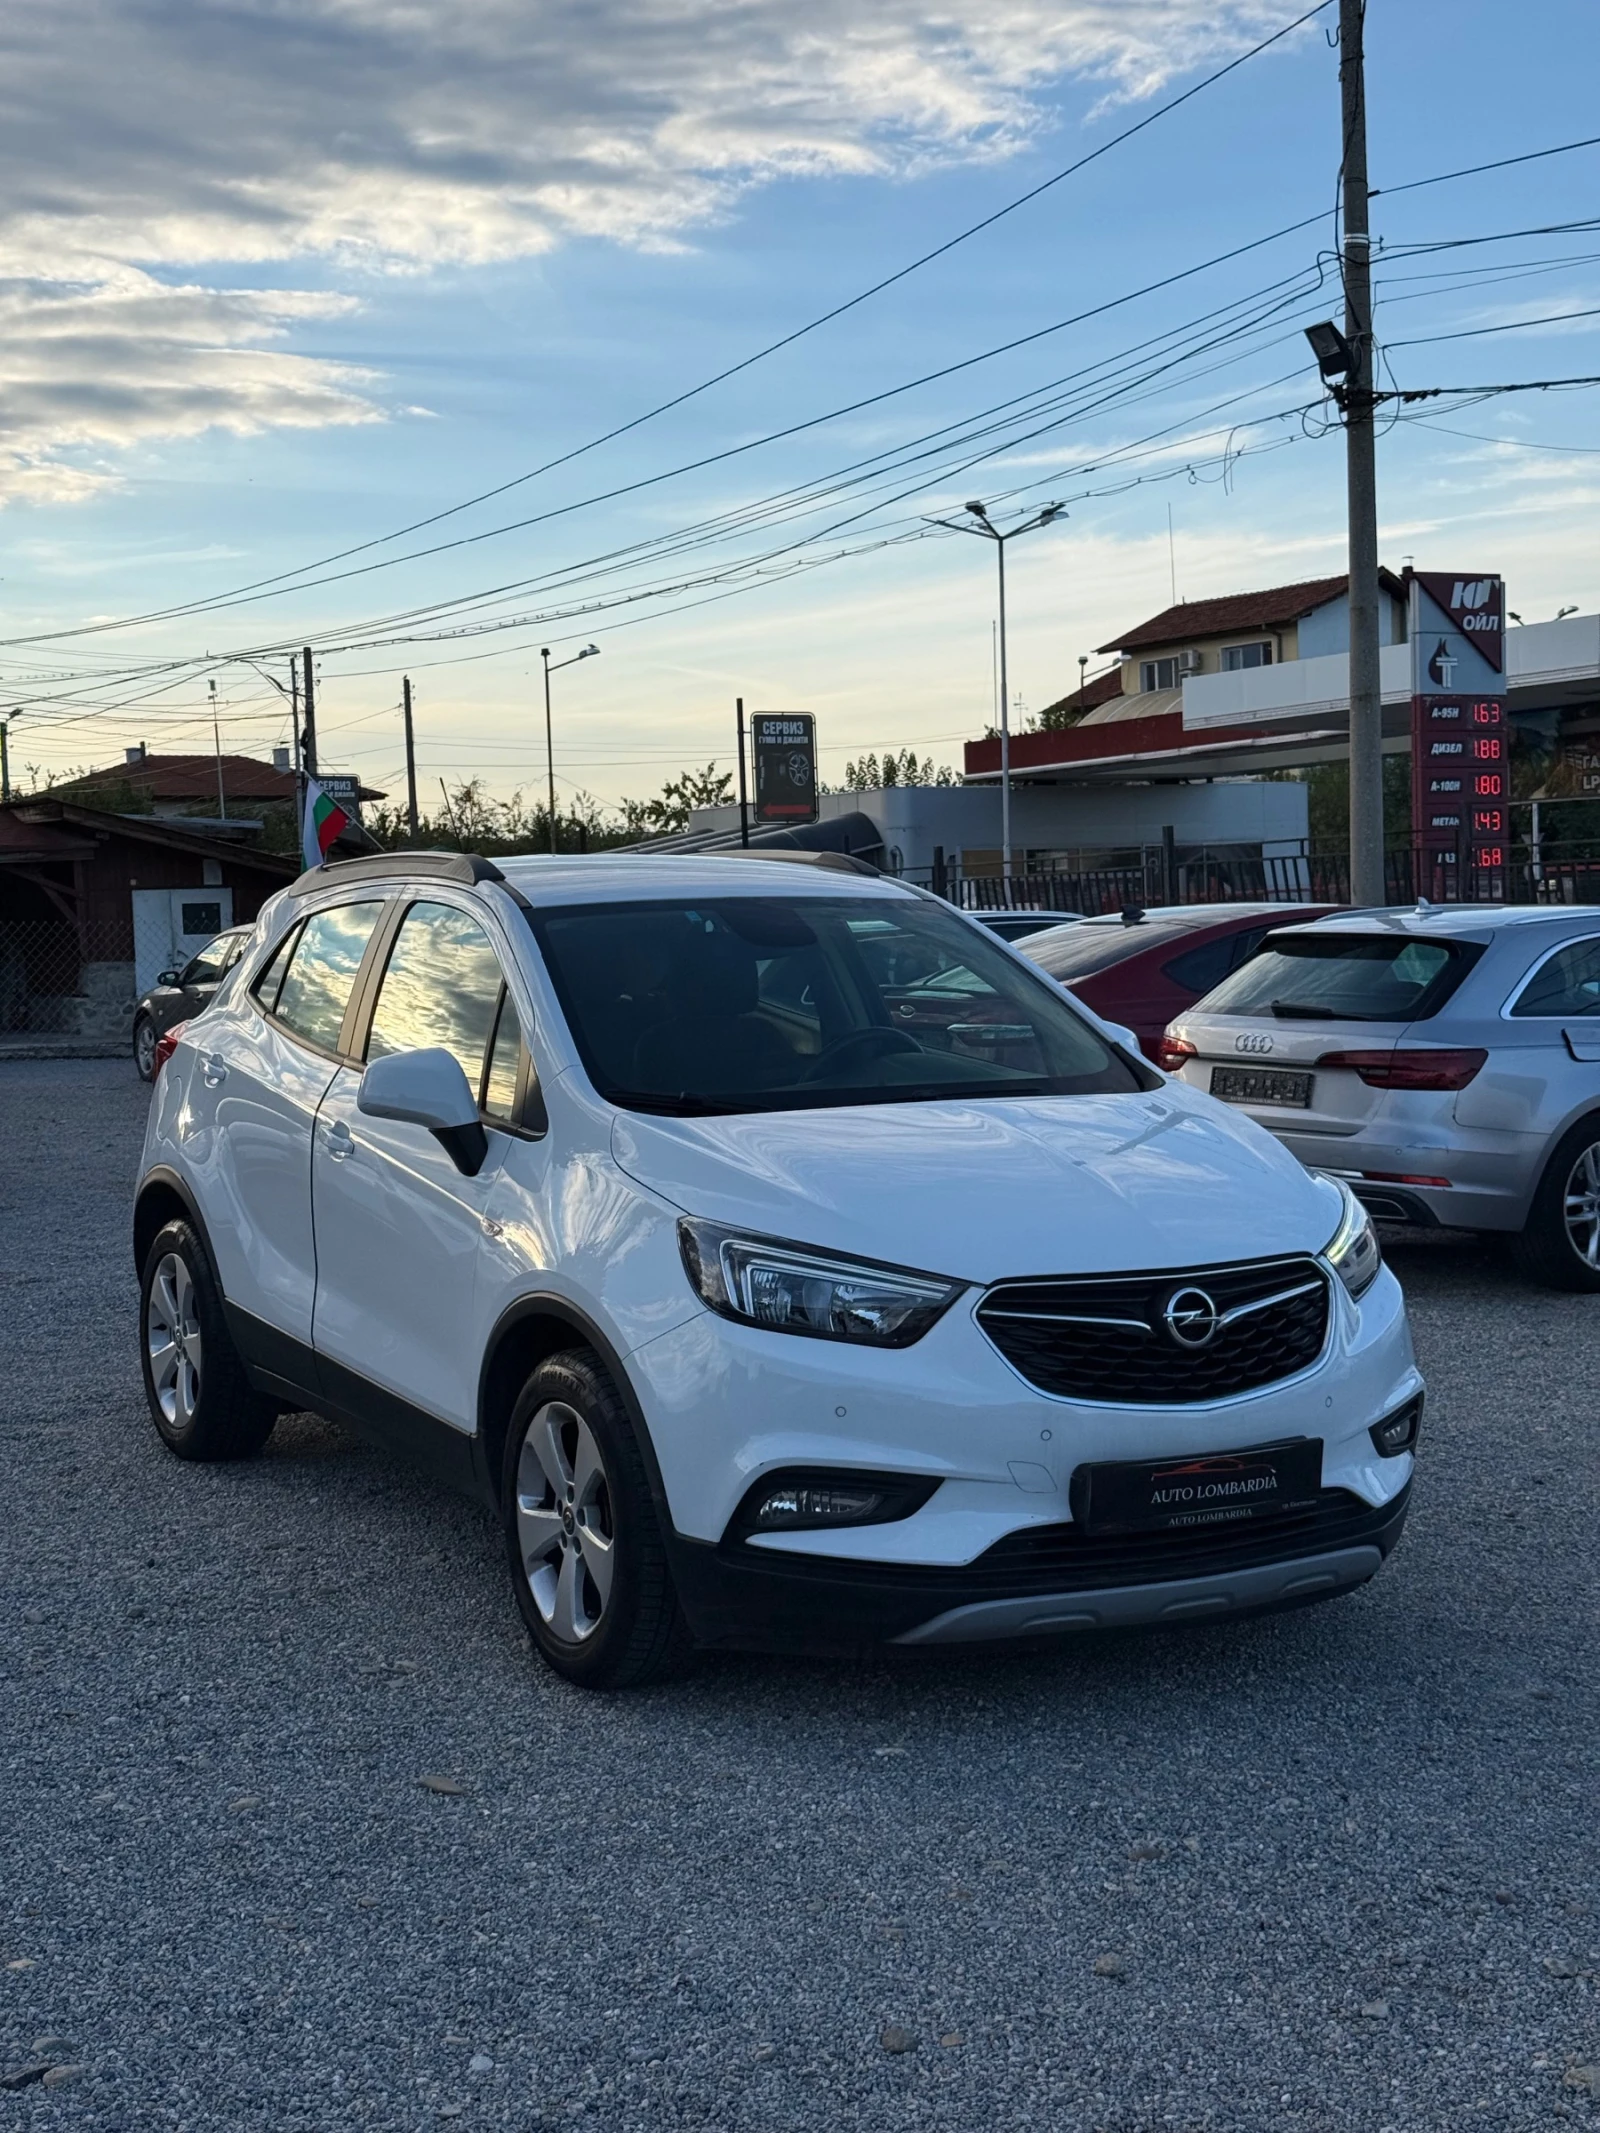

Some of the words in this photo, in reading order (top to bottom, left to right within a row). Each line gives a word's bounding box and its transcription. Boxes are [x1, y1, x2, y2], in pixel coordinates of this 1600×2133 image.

[1462, 612, 1499, 631] ОЙЛ
[762, 721, 804, 735] СЕРВИЗ
[1430, 743, 1463, 755] ДИЗЕЛ
[318, 780, 351, 790] СЕРВИЗ
[1151, 1487, 1194, 1504] AUTO
[1197, 1475, 1278, 1499] LOMBARDIA
[1168, 1516, 1195, 1527] AUTO
[1197, 1508, 1253, 1523] LOMBARDIA
